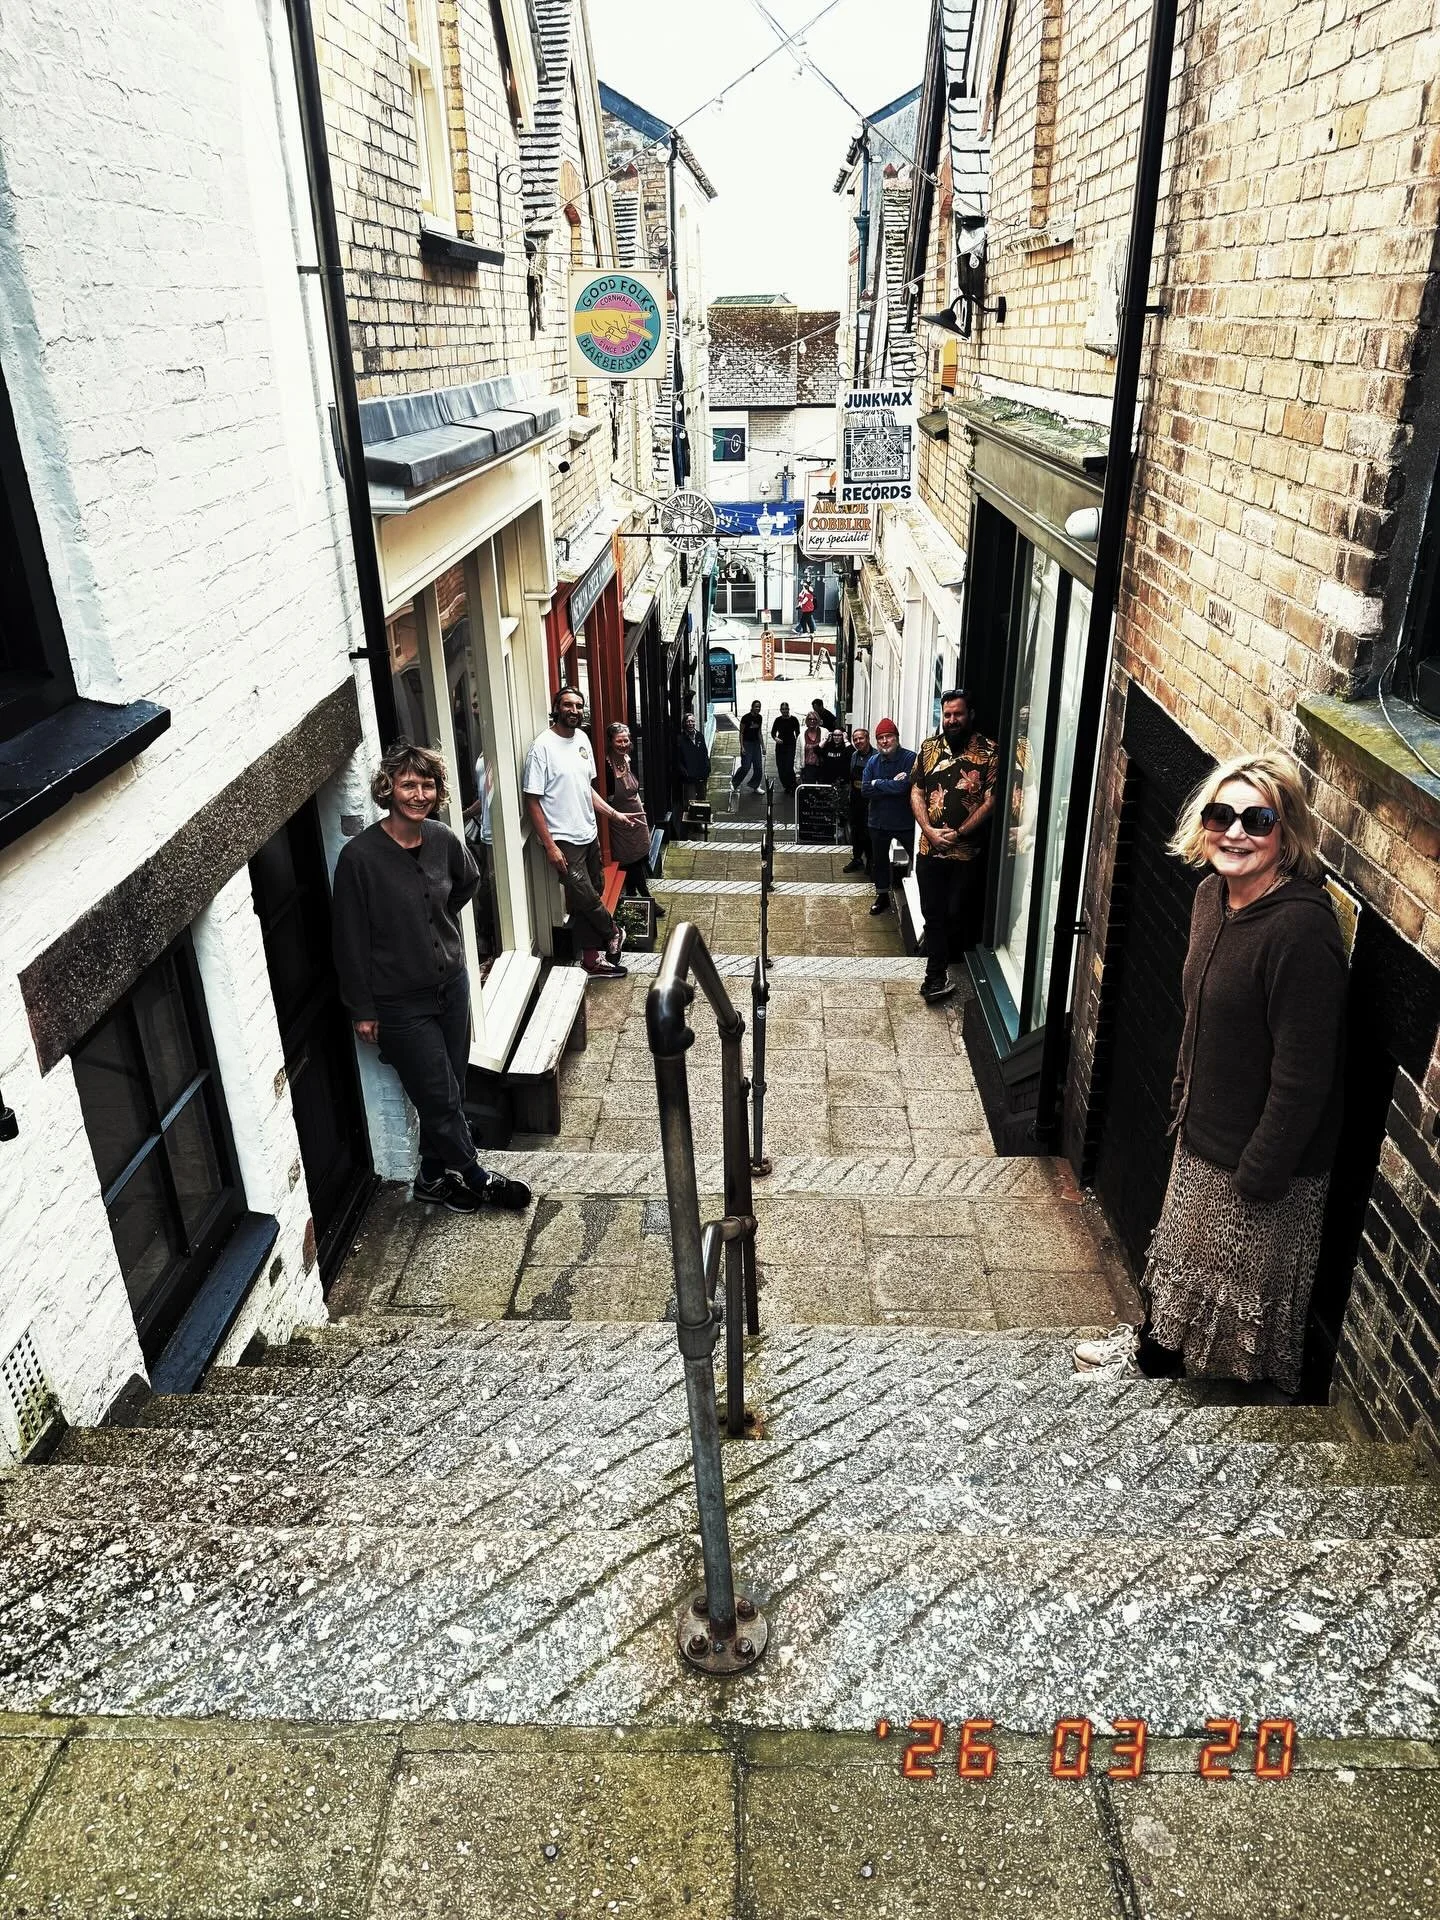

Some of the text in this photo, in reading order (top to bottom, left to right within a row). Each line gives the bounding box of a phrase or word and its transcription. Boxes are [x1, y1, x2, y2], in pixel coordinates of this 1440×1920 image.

[582, 279, 655, 314] GOOD FOLKS
[600, 294, 633, 307] CORNWALL
[580, 337, 653, 370] BARBERSHOP
[598, 340, 637, 354] SINCE 2010
[844, 391, 912, 408] JUNKWAX
[842, 485, 912, 501] RECORDS
[812, 501, 869, 514] ARCADE
[808, 517, 872, 531] COBBLER
[808, 532, 870, 550] Key Specialist
